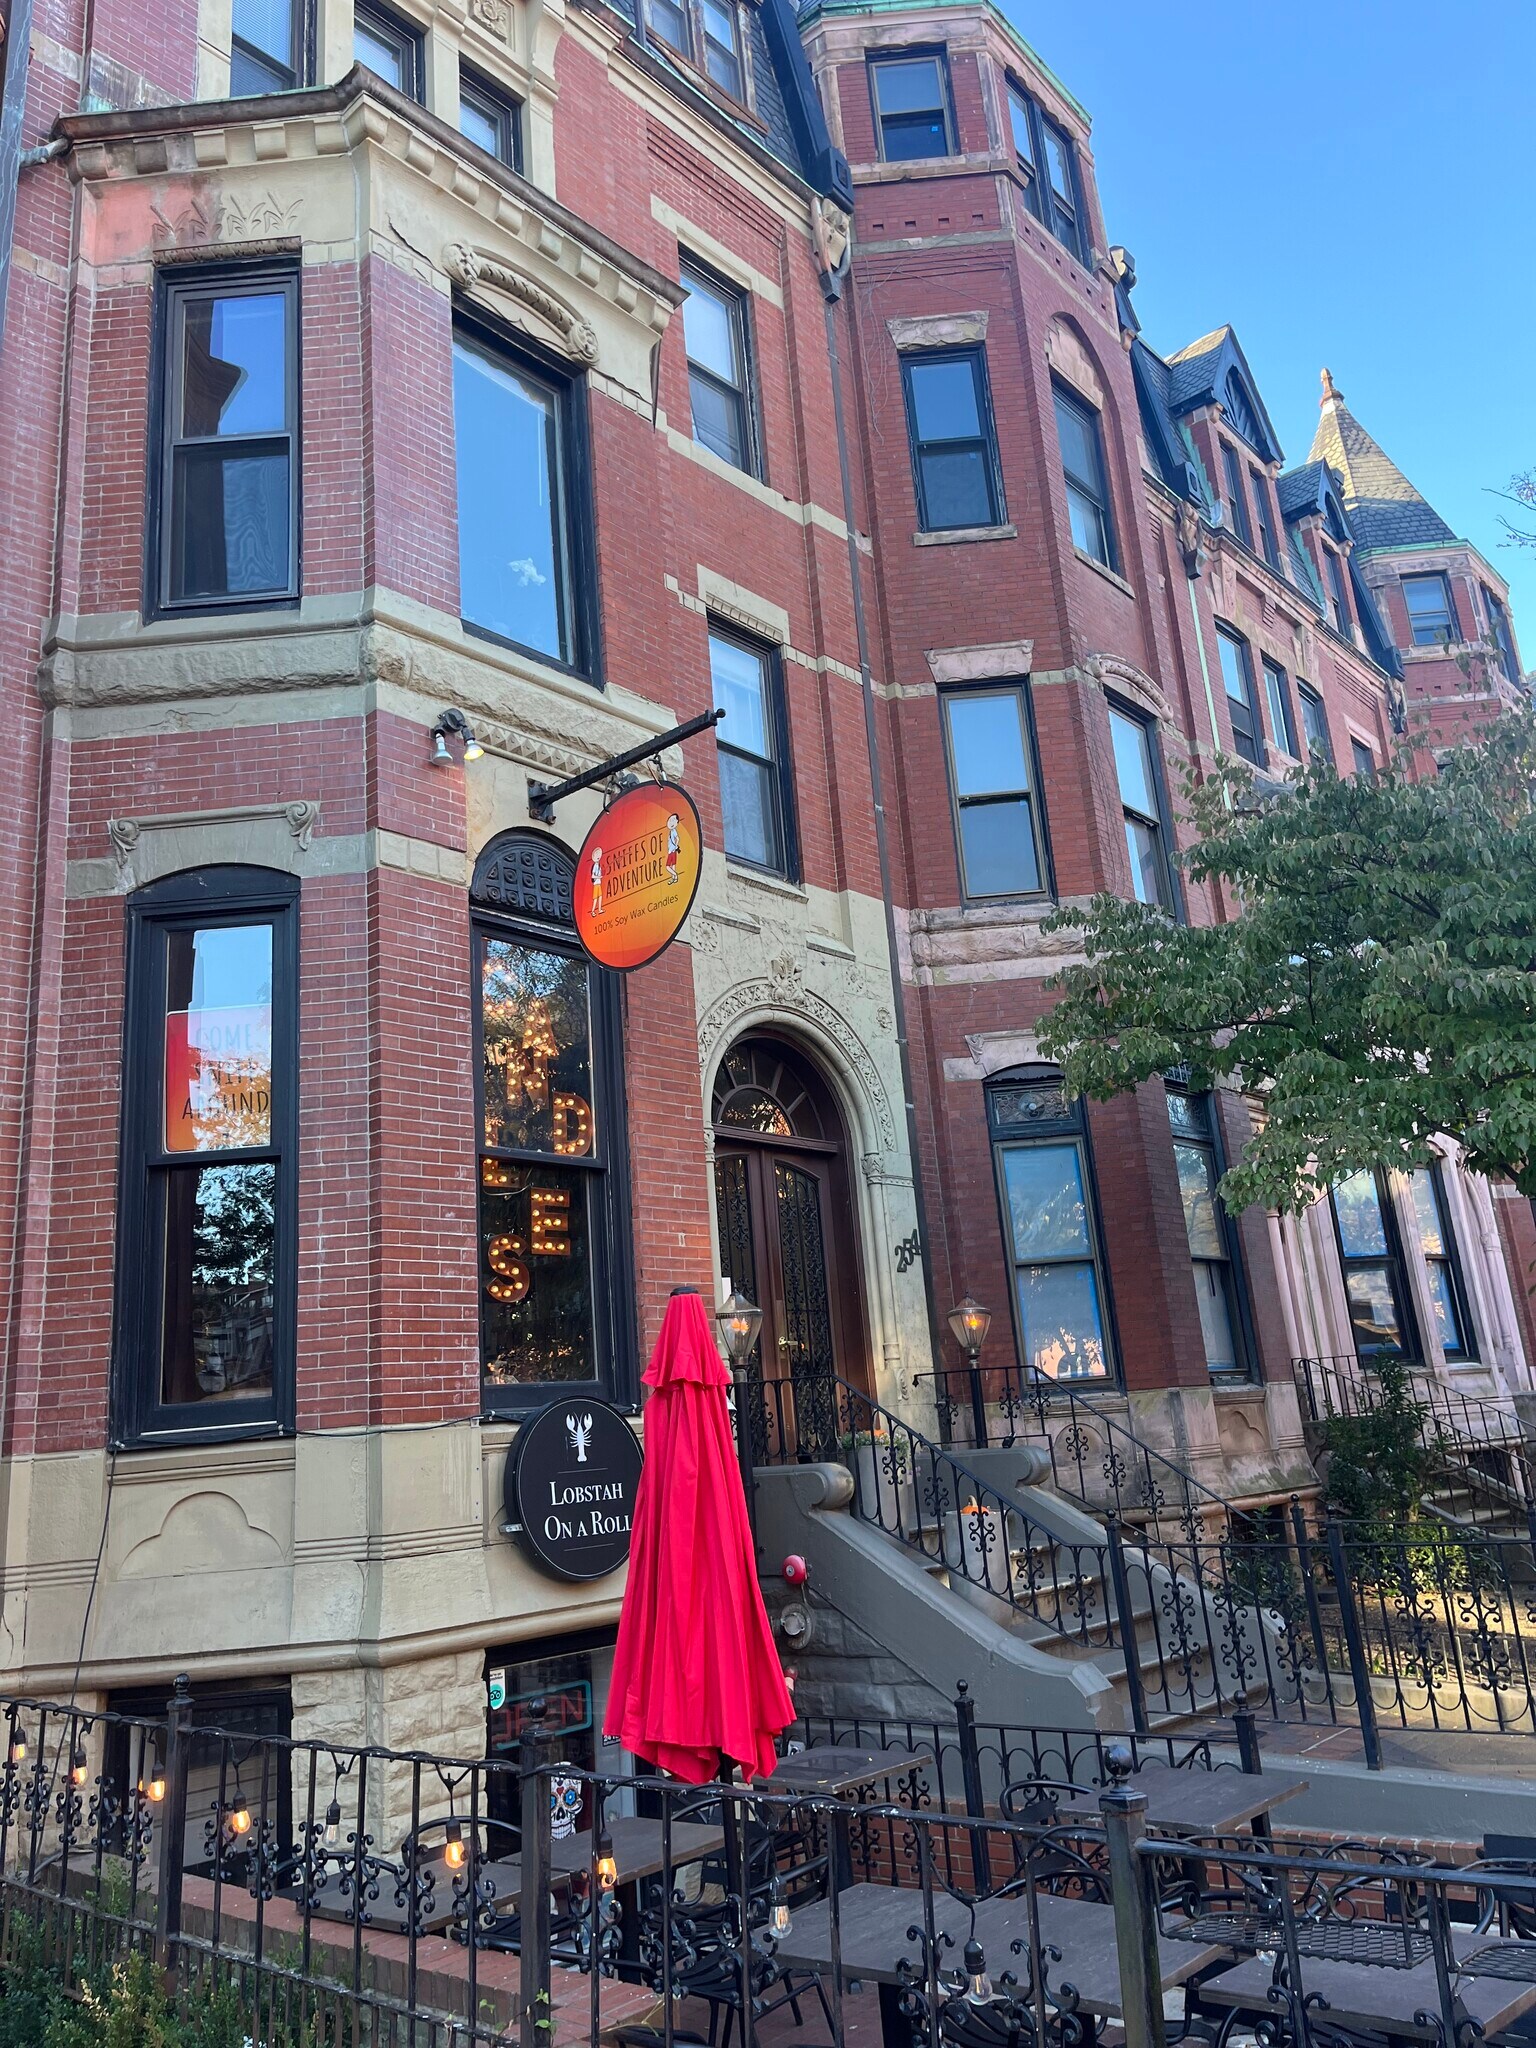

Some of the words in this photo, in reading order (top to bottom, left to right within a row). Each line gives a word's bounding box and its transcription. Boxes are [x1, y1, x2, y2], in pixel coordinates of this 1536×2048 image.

[606, 840, 646, 875] SNIFFS
[650, 833, 663, 856] OF
[606, 857, 663, 898] ADVENTURE
[594, 920, 614, 936] 100%
[615, 914, 629, 926] Soy
[630, 908, 646, 920] Wax
[647, 894, 679, 912] Candles
[195, 1024, 252, 1054] COME
[895, 1229, 921, 1272] 254
[549, 1481, 623, 1506] LOBSTAH
[544, 1515, 572, 1541] ON
[577, 1522, 588, 1537] A
[590, 1510, 633, 1536] ROLL
